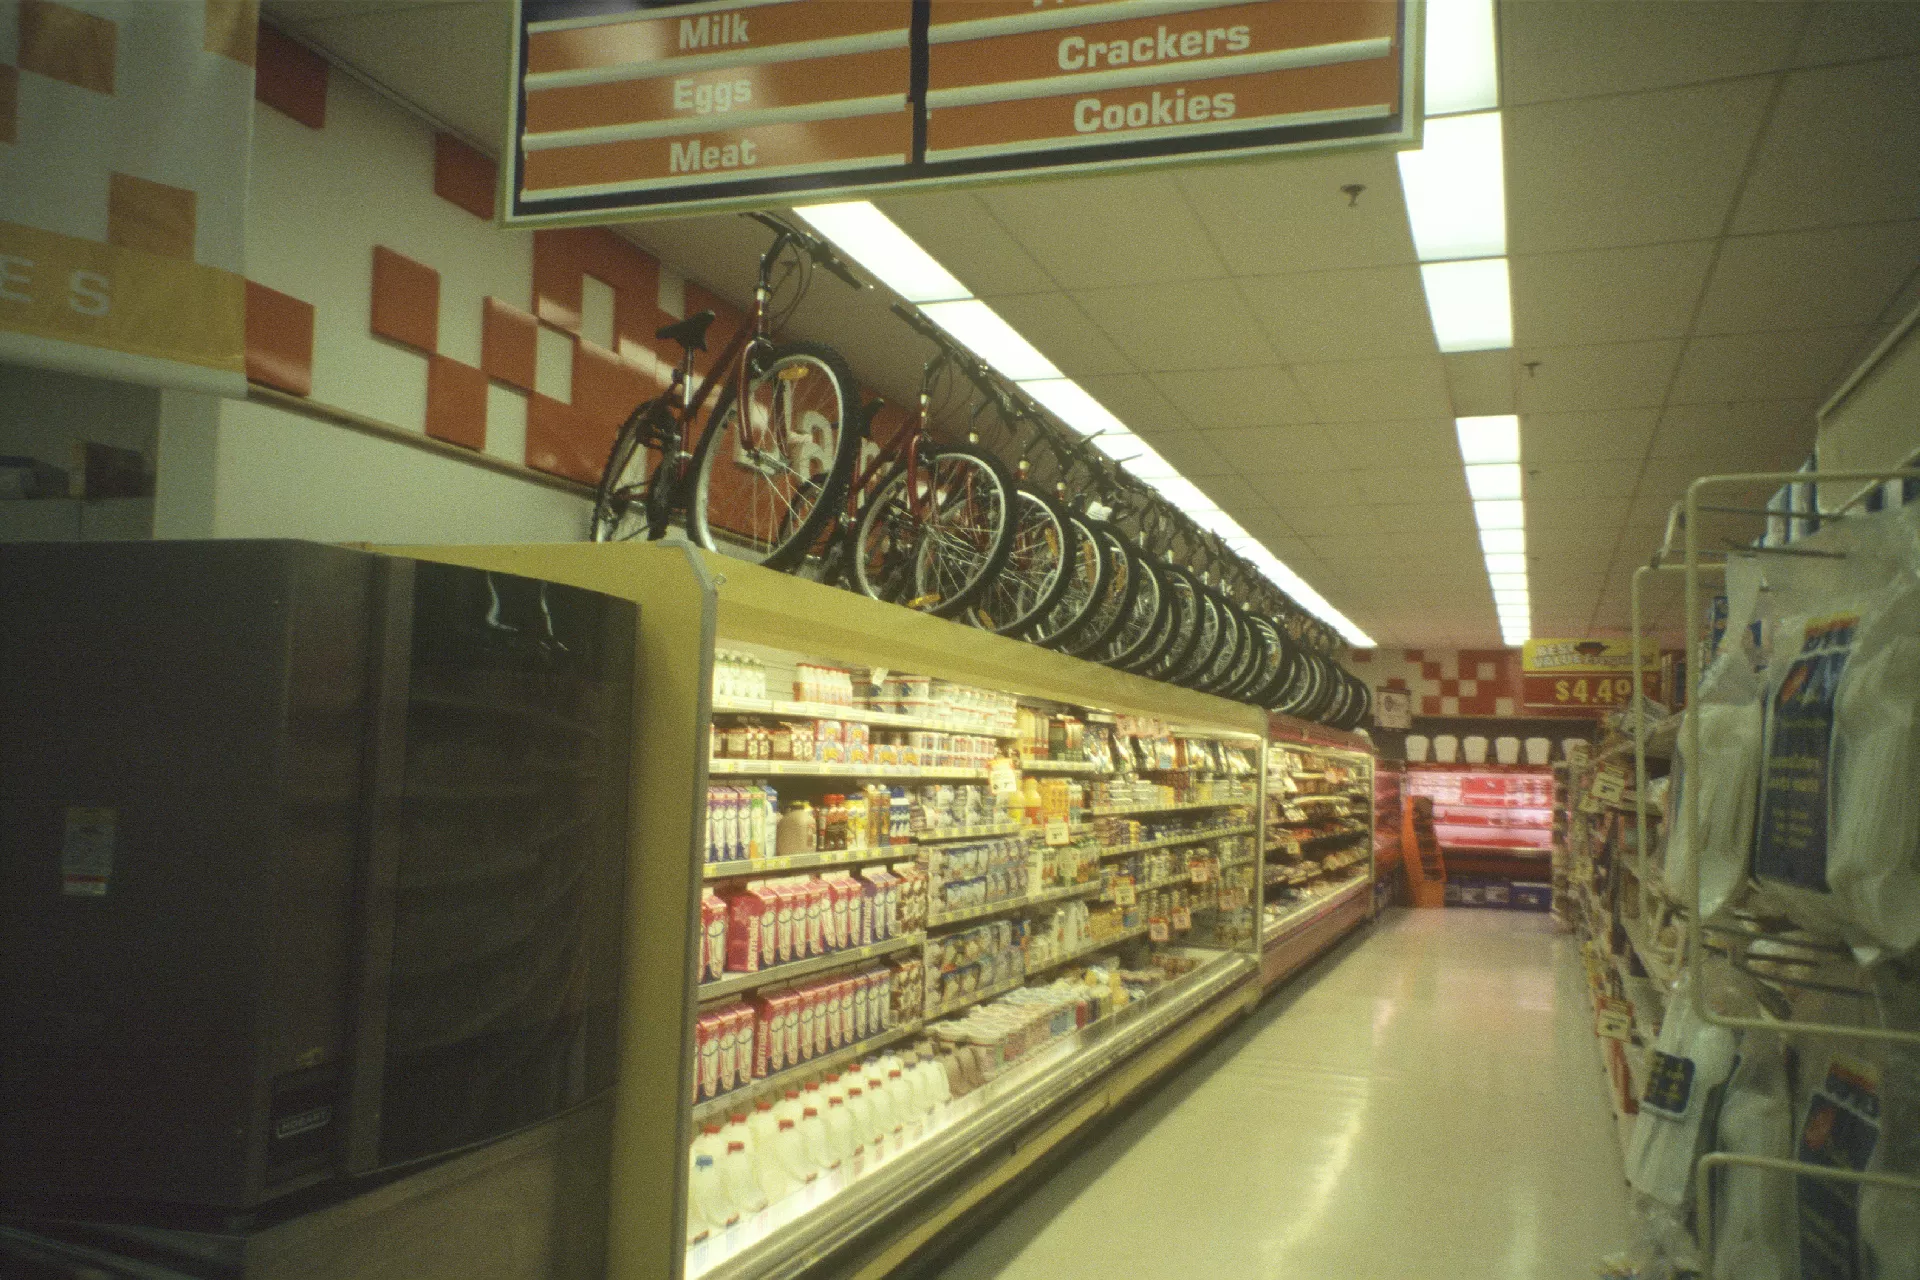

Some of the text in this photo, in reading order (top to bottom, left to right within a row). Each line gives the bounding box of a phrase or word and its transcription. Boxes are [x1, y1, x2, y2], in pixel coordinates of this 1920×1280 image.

[679, 14, 749, 49] Milk
[1057, 25, 1250, 70] Crackers
[673, 78, 751, 113] Eggs
[1074, 89, 1236, 132] Cookies
[669, 139, 757, 172] Meat
